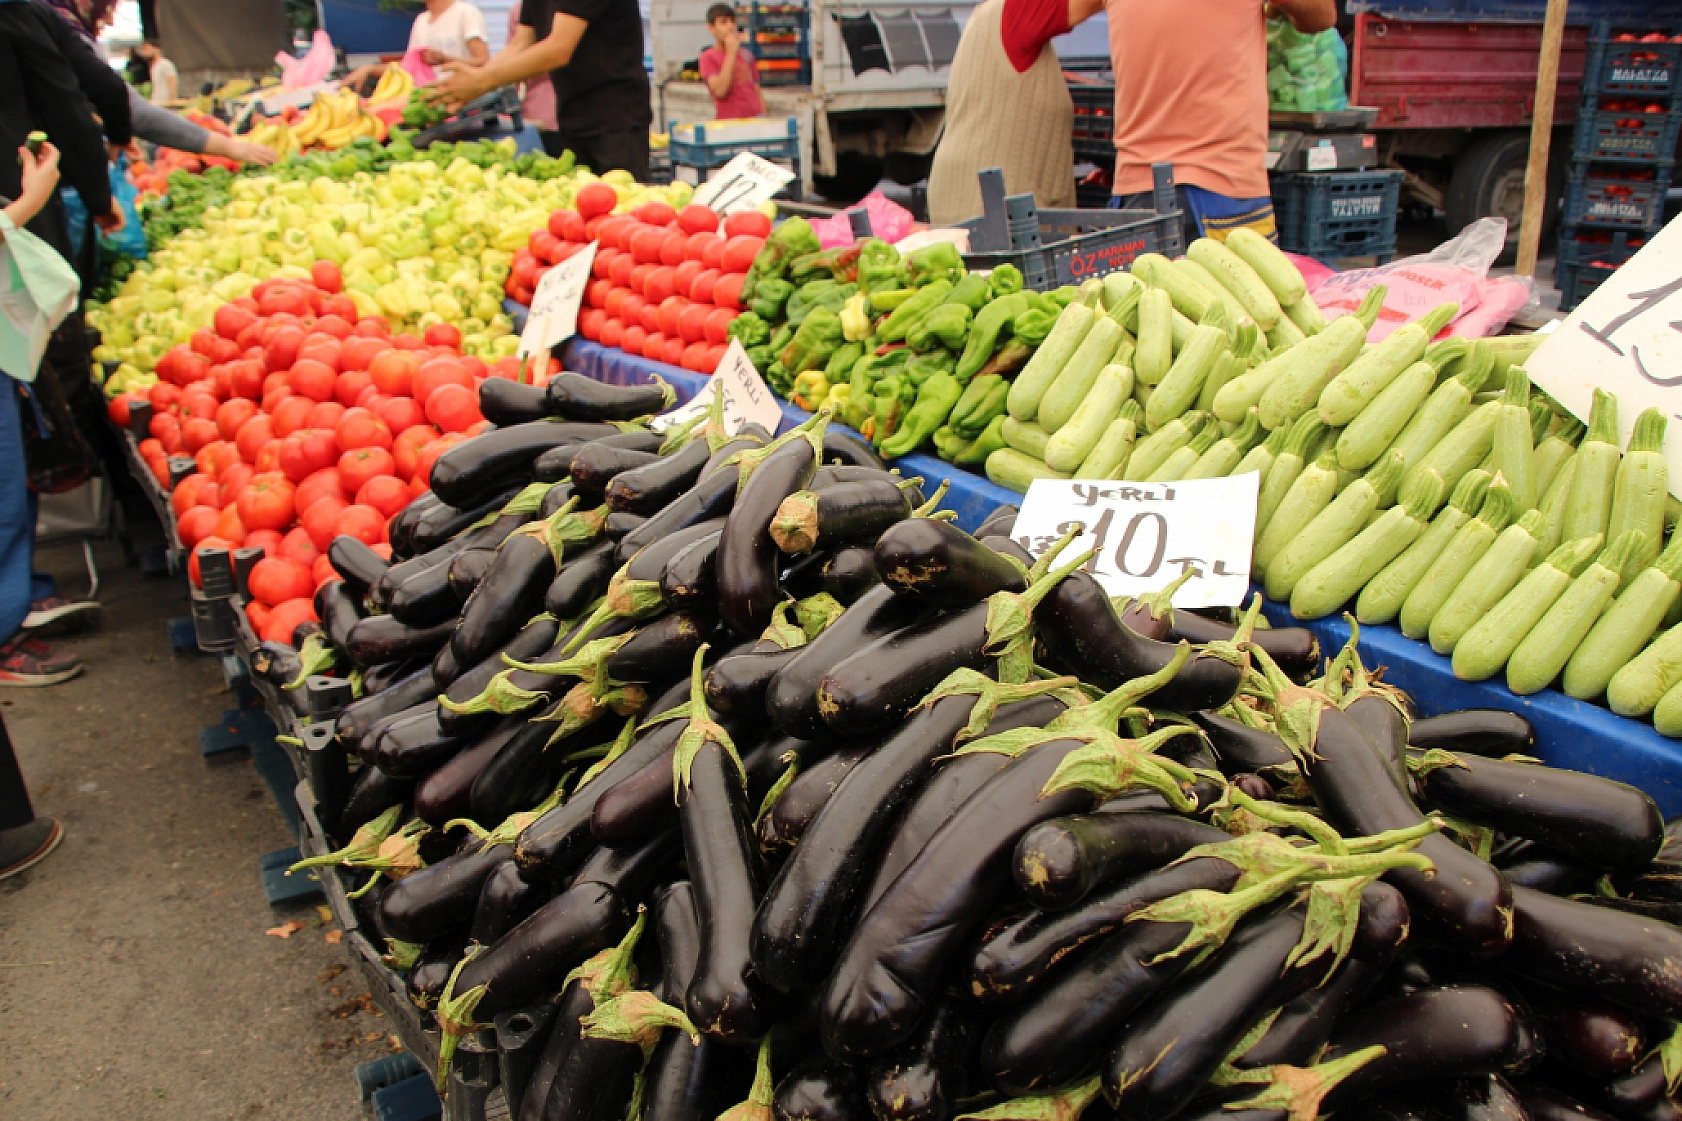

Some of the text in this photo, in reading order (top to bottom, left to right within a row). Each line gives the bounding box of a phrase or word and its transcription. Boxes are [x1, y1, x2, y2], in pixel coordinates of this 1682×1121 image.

[1070, 239, 1146, 277] ÖZ KARAMAN
[1087, 508, 1168, 578] 10
[1167, 556, 1249, 579] TL
